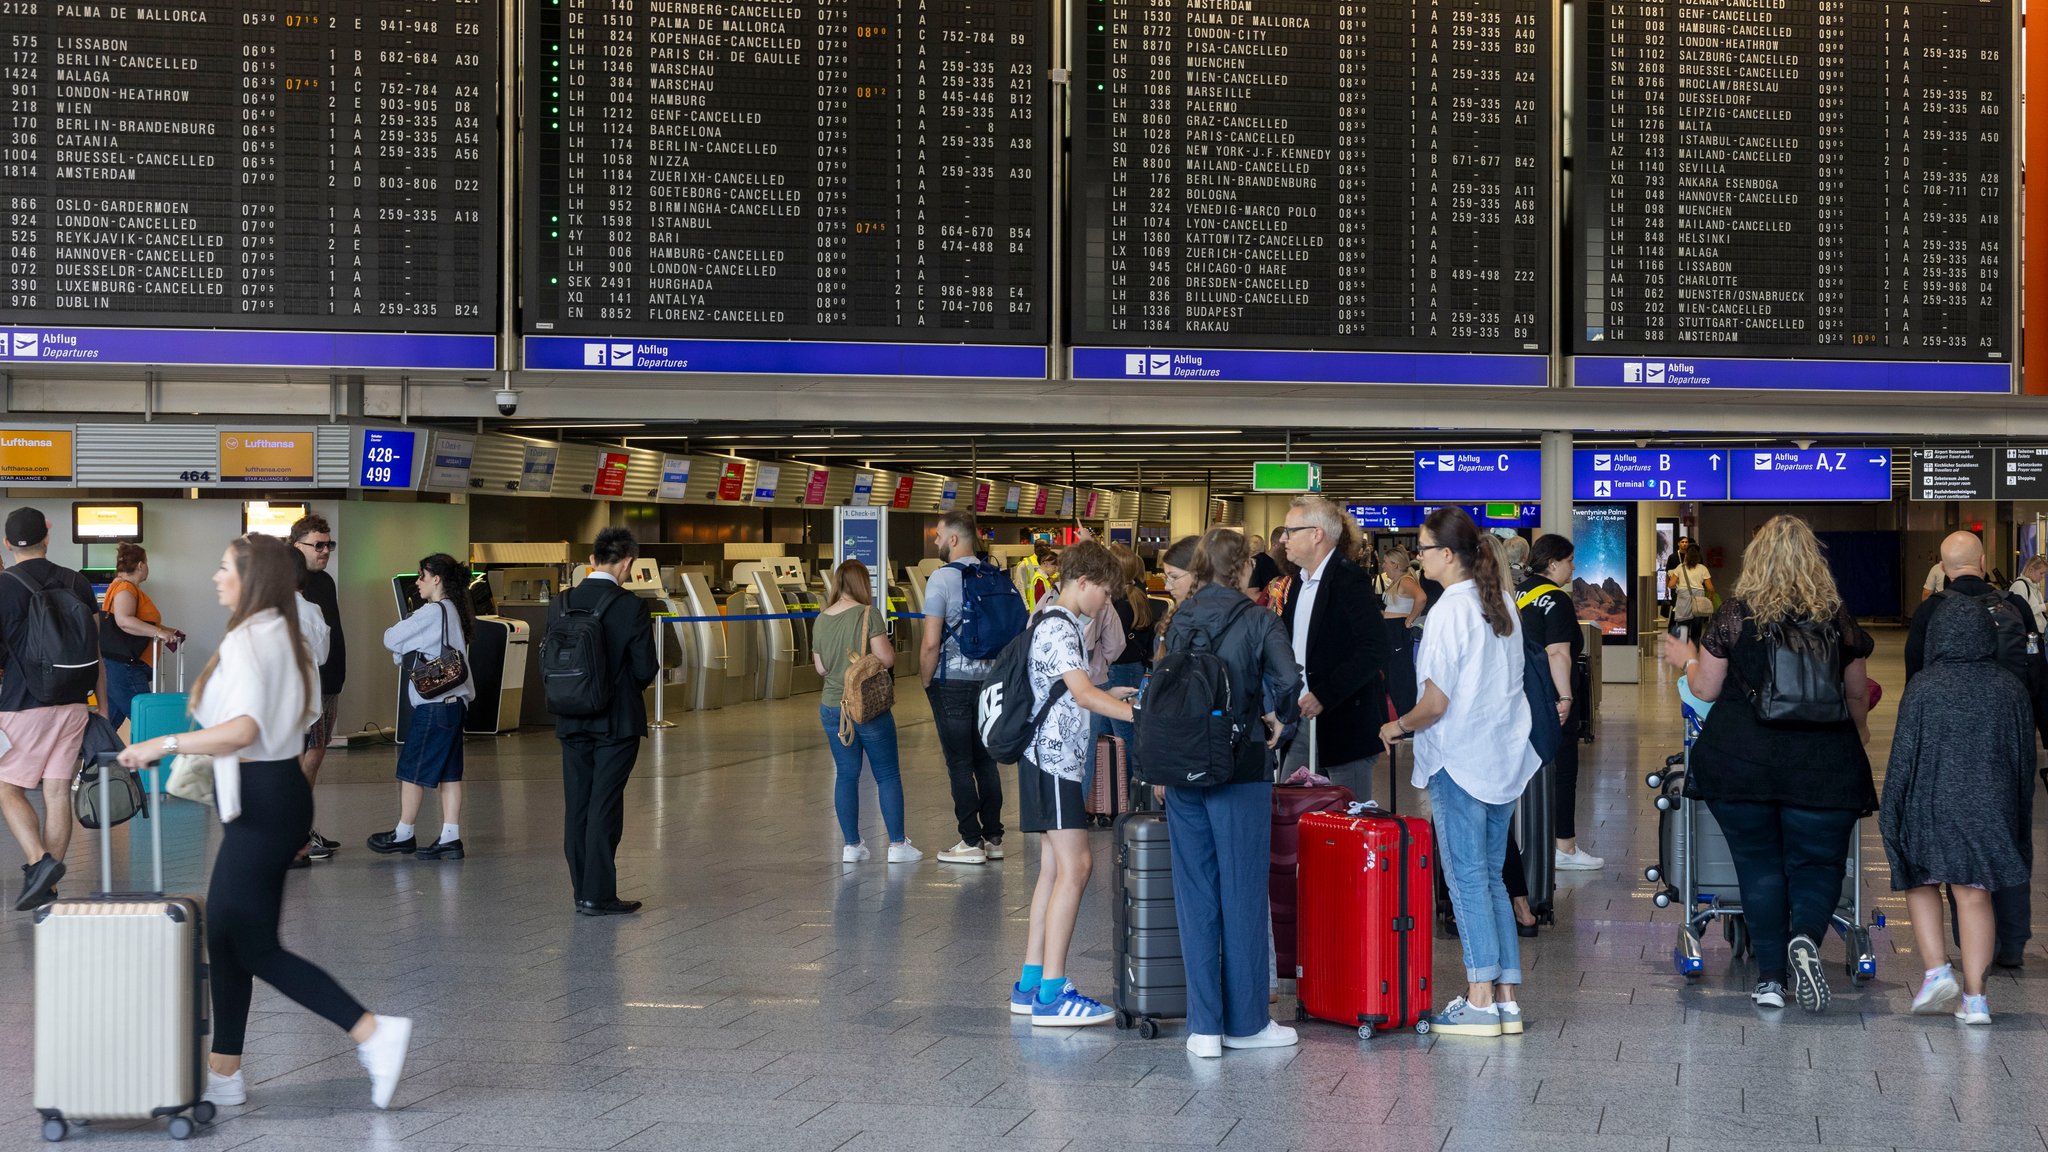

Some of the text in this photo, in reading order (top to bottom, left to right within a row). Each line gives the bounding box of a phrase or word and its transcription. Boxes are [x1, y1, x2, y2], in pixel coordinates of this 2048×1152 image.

[58, 5, 206, 22] PALMA DE MALLORCA
[651, 4, 800, 19] NUERNBERG-CANCELLED
[651, 17, 785, 33] PALMA DE MALLORCA
[1188, 13, 1310, 28] PALMA DE MALLORCA
[1188, 28, 1266, 40] LONDON-CITY
[13, 36, 478, 66] 575 LISSABON 682-684 A30
[651, 48, 800, 64] PARIS CH. DE GAULLE
[1188, 57, 1244, 68] MUENCHEN
[651, 63, 713, 76] WARSCHAU
[58, 70, 109, 82] MALAGA
[651, 78, 713, 91] WARSCHAU
[1679, 79, 1778, 92] WROCLAW/BRESLAU
[58, 86, 189, 101] LONDON-HEATHROW
[1187, 86, 1250, 98] MARSEILLE
[1680, 92, 1751, 104] DUESSELDORF
[651, 94, 705, 106] HAMBURG
[57, 102, 91, 114] WIEN
[1187, 101, 1236, 112] PALERMO
[57, 118, 214, 134] BERLIN-BRANDENBURG
[651, 125, 721, 137] BARCELONA
[1679, 121, 1712, 131] MALTA
[58, 134, 118, 147] CATANIA
[1681, 135, 1798, 148] ISTANBUL-CANCELLED
[1187, 145, 1330, 159] NEW YORK-J.F.KENNEDY
[58, 151, 214, 166] BRUESSEL-CANCELLED
[650, 155, 689, 166] NIZZA
[1187, 160, 1309, 173] MAILAND-CANCELLED
[1680, 162, 1725, 173] SEVILLA
[57, 167, 135, 180] AMSTERDAM
[650, 171, 784, 185] ZUERIXH-CANCELLED
[1187, 174, 1316, 188] BERLIN-BRANDENBURG
[1679, 177, 1778, 189] ANKARA ESENBOGA
[650, 186, 800, 201] GOETEBORG-CANCELLED
[1187, 189, 1236, 200] BOLOGNA
[57, 199, 188, 213] OSLO-GARDERMOEN
[650, 201, 800, 216] BIRMINGHA-CANCELLED
[1187, 204, 1316, 217] VENEDIG-MARCO POLO
[1679, 205, 1731, 216] MUENCHEN
[652, 217, 712, 228] ISTANBUL
[57, 232, 223, 246] REYKJAVIK-CANCELLED
[650, 232, 678, 243] BARI
[1187, 233, 1323, 246] KATTOWITZ-CANCELLED
[1679, 233, 1729, 243] HELSINKI
[57, 248, 214, 262] HANNOVER-CANCELLED
[1187, 248, 1308, 260] ZUERICH-CANCELLED
[1679, 247, 1718, 257] MALAGA
[57, 264, 222, 278] DUESSELDR-CANCELLED
[1187, 262, 1286, 274] CHICAGO-O HARE
[1679, 261, 1731, 272] LISSABON
[57, 280, 222, 294] LUXEMBURG-CANCELLED
[650, 278, 712, 290] HURGHADA
[1646, 274, 1966, 291] 705 CHARLOTTE 959-968
[1679, 289, 1804, 301] MUENSTER/OSNABRUECK
[57, 296, 108, 308] DUBLIN
[611, 293, 1030, 312] 141 ANTALYA 704-706 B47
[650, 309, 784, 322] FLORENZ-CANCELLED
[1187, 306, 1243, 317] BUDAPEST
[1187, 321, 1228, 331] KRAKAU
[1679, 317, 1804, 329] STUTTGART-CANCELLED
[43, 334, 76, 346] Abflug
[1679, 331, 1737, 341] AMSTERDAM
[43, 347, 98, 359] Departures
[637, 345, 668, 356] Abflug
[638, 358, 688, 368] Departures
[1174, 355, 1202, 366] Abflug
[1174, 367, 1220, 378] Departures
[1668, 364, 1694, 374] Abflug
[1668, 375, 1710, 385] Departures
[1, 438, 52, 446] Lufthansa
[245, 440, 294, 448] Lufthansa
[368, 448, 400, 462] 428-
[1458, 455, 1480, 463] Abflug
[1614, 454, 1636, 463] Abflug
[1775, 454, 1798, 462] Abflug
[1458, 464, 1494, 472] Departures
[1498, 454, 1509, 471] C
[1614, 464, 1651, 472] Departures
[1660, 454, 1670, 471] B
[1775, 463, 1813, 471] Departures
[180, 471, 210, 481] 464
[366, 467, 391, 482] 499
[1382, 507, 1387, 515] C
